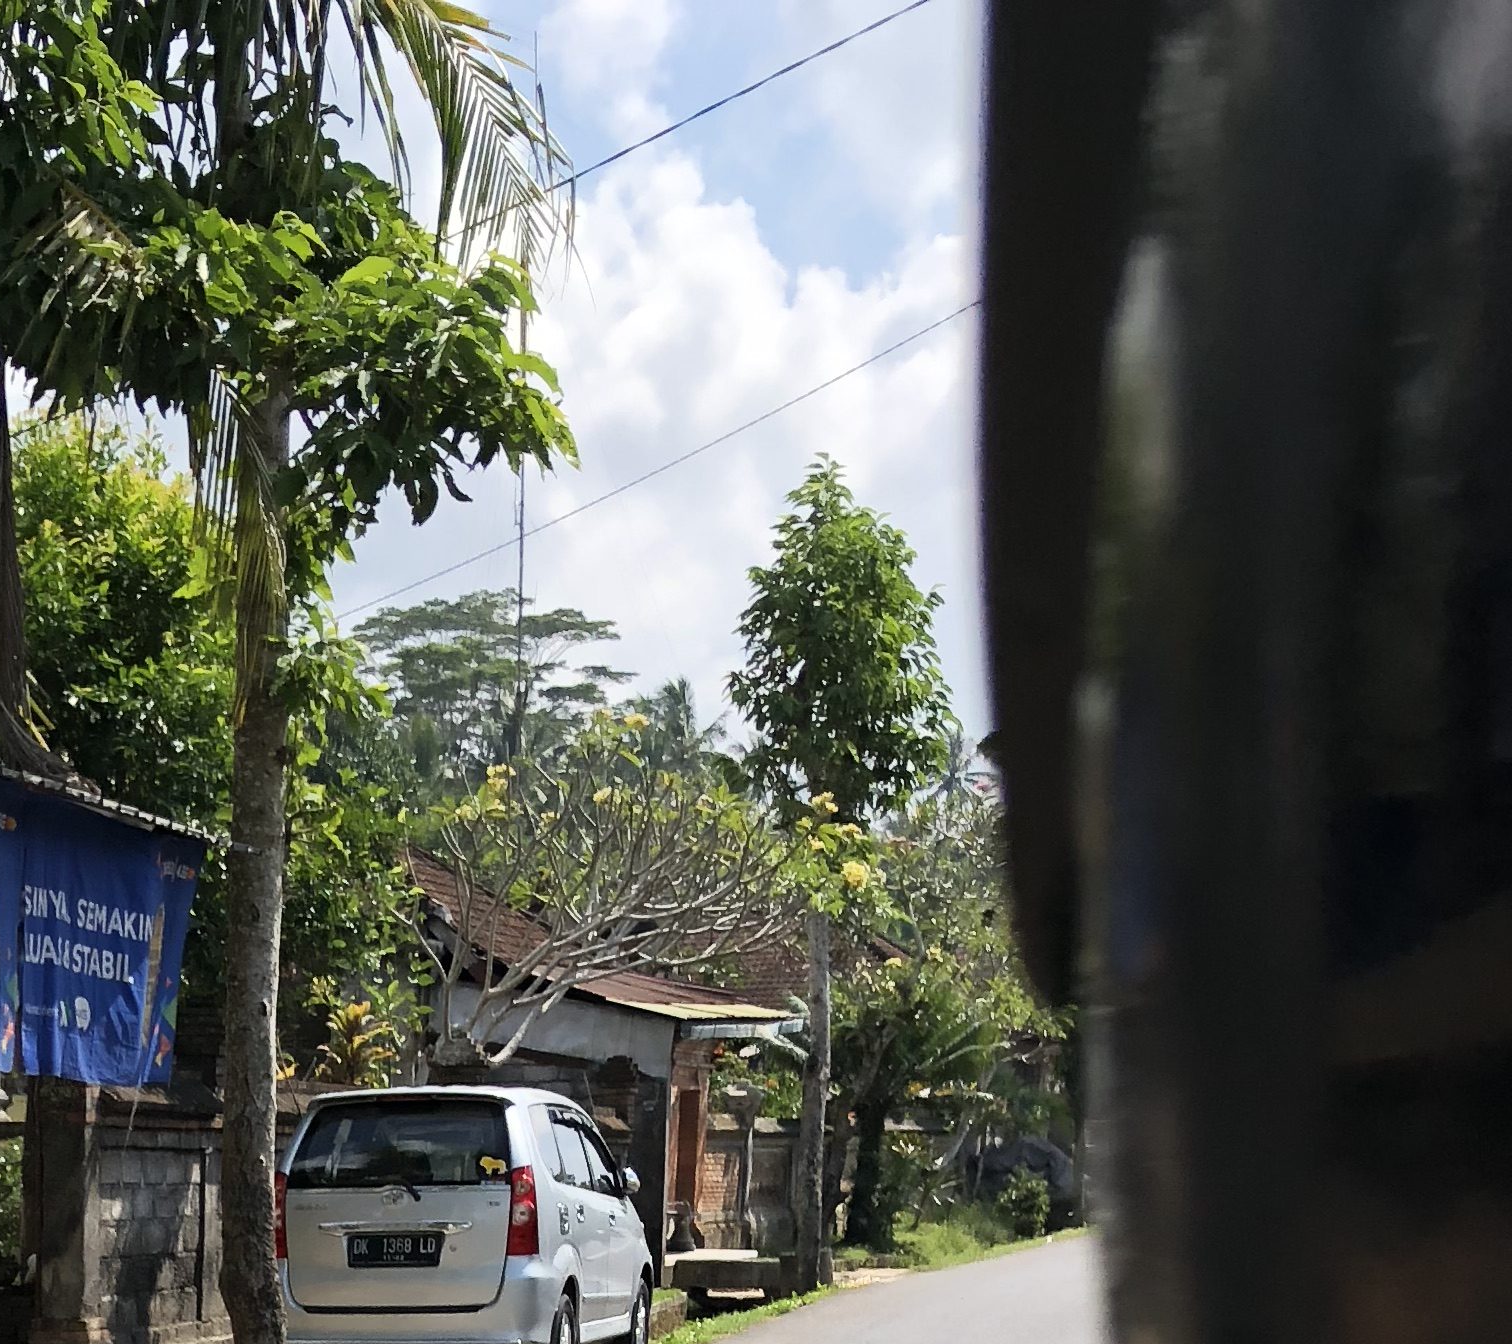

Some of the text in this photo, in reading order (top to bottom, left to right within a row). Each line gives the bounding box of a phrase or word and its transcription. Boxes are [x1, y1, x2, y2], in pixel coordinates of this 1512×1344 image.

[77, 898, 154, 942] SEMAKIN
[72, 943, 134, 984] STABIL
[353, 1237, 436, 1254] DK 1368 LD
